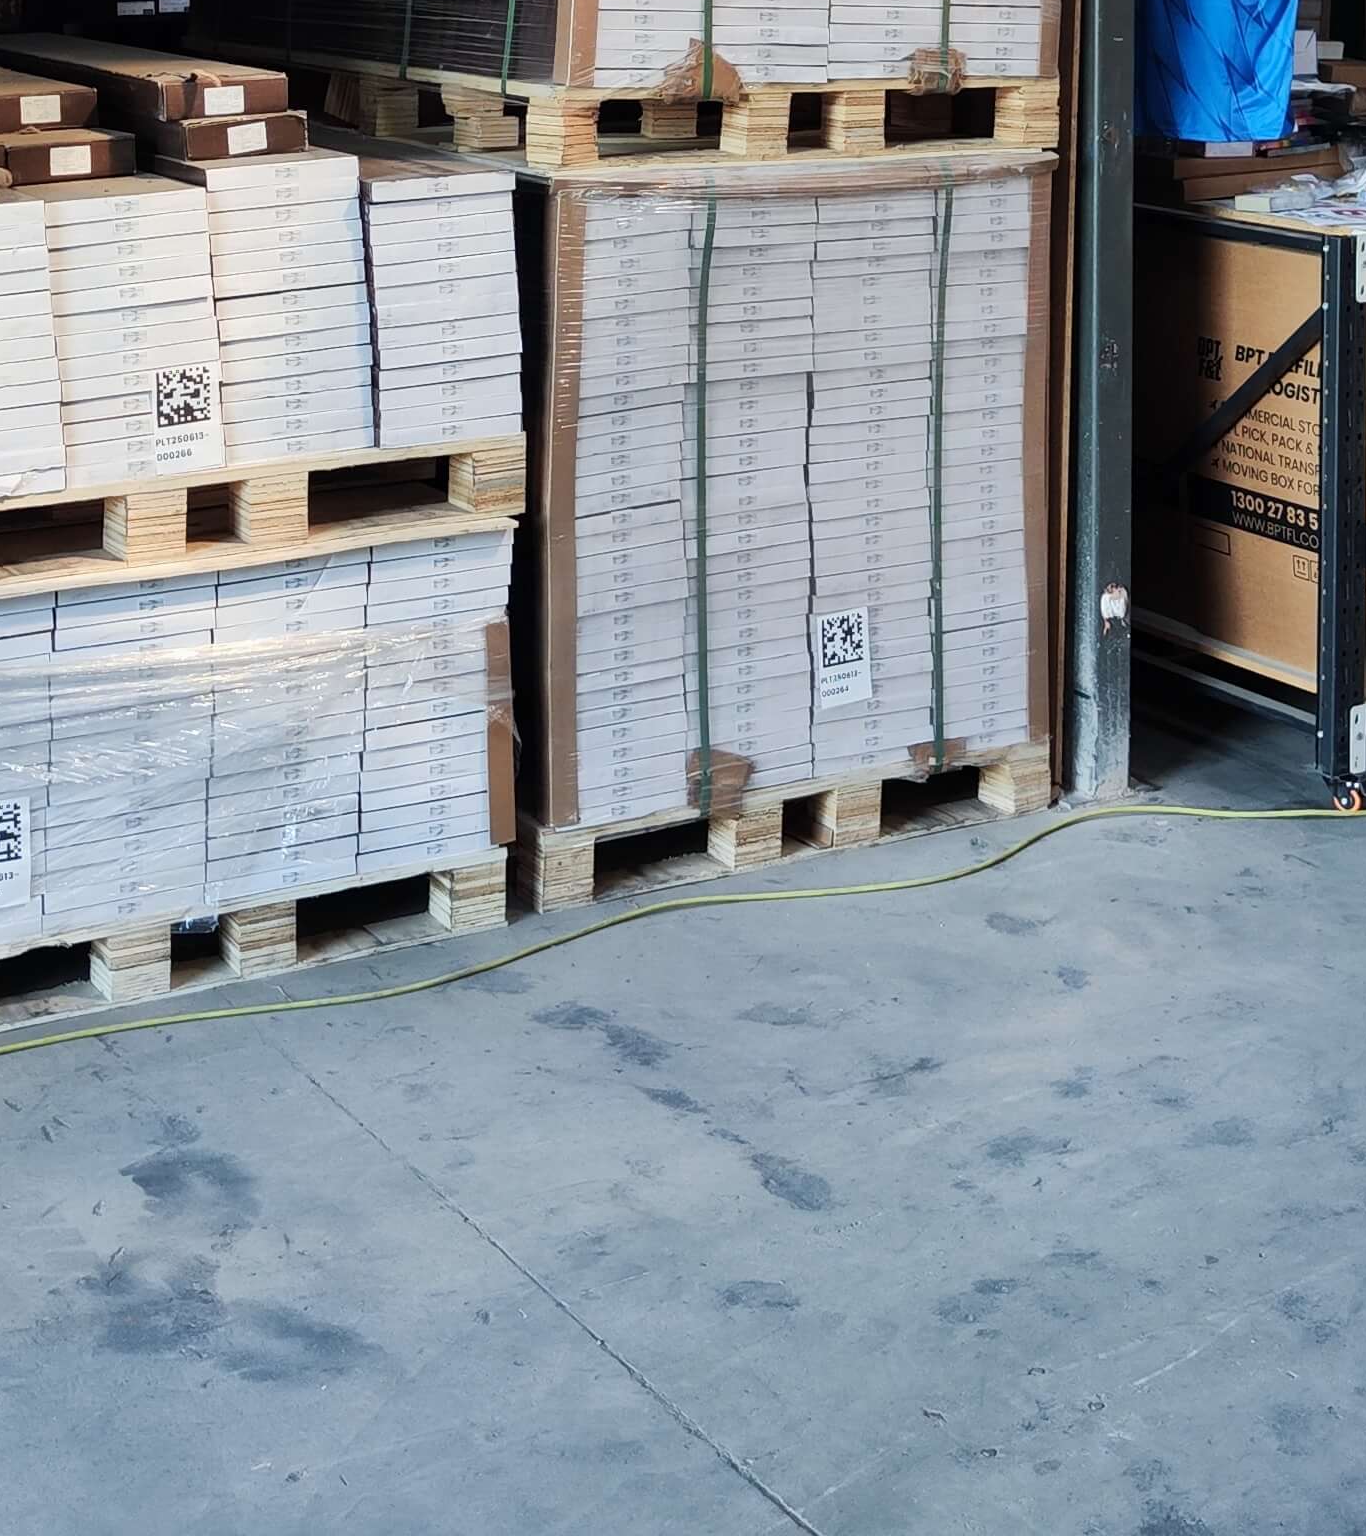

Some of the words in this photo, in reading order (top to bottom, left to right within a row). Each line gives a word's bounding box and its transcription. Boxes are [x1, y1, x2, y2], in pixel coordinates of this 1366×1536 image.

[1235, 345, 1265, 365] BPT
[1267, 379, 1320, 404] OGIST
[1222, 439, 1275, 465] NATIONAL
[1272, 433, 1302, 452] PACK
[1305, 442, 1314, 456] &
[1222, 459, 1268, 482] MOVING
[1271, 472, 1294, 491] BOX
[1230, 490, 1264, 514] 1300
[1267, 501, 1283, 520] 27
[1286, 506, 1305, 527] 83
